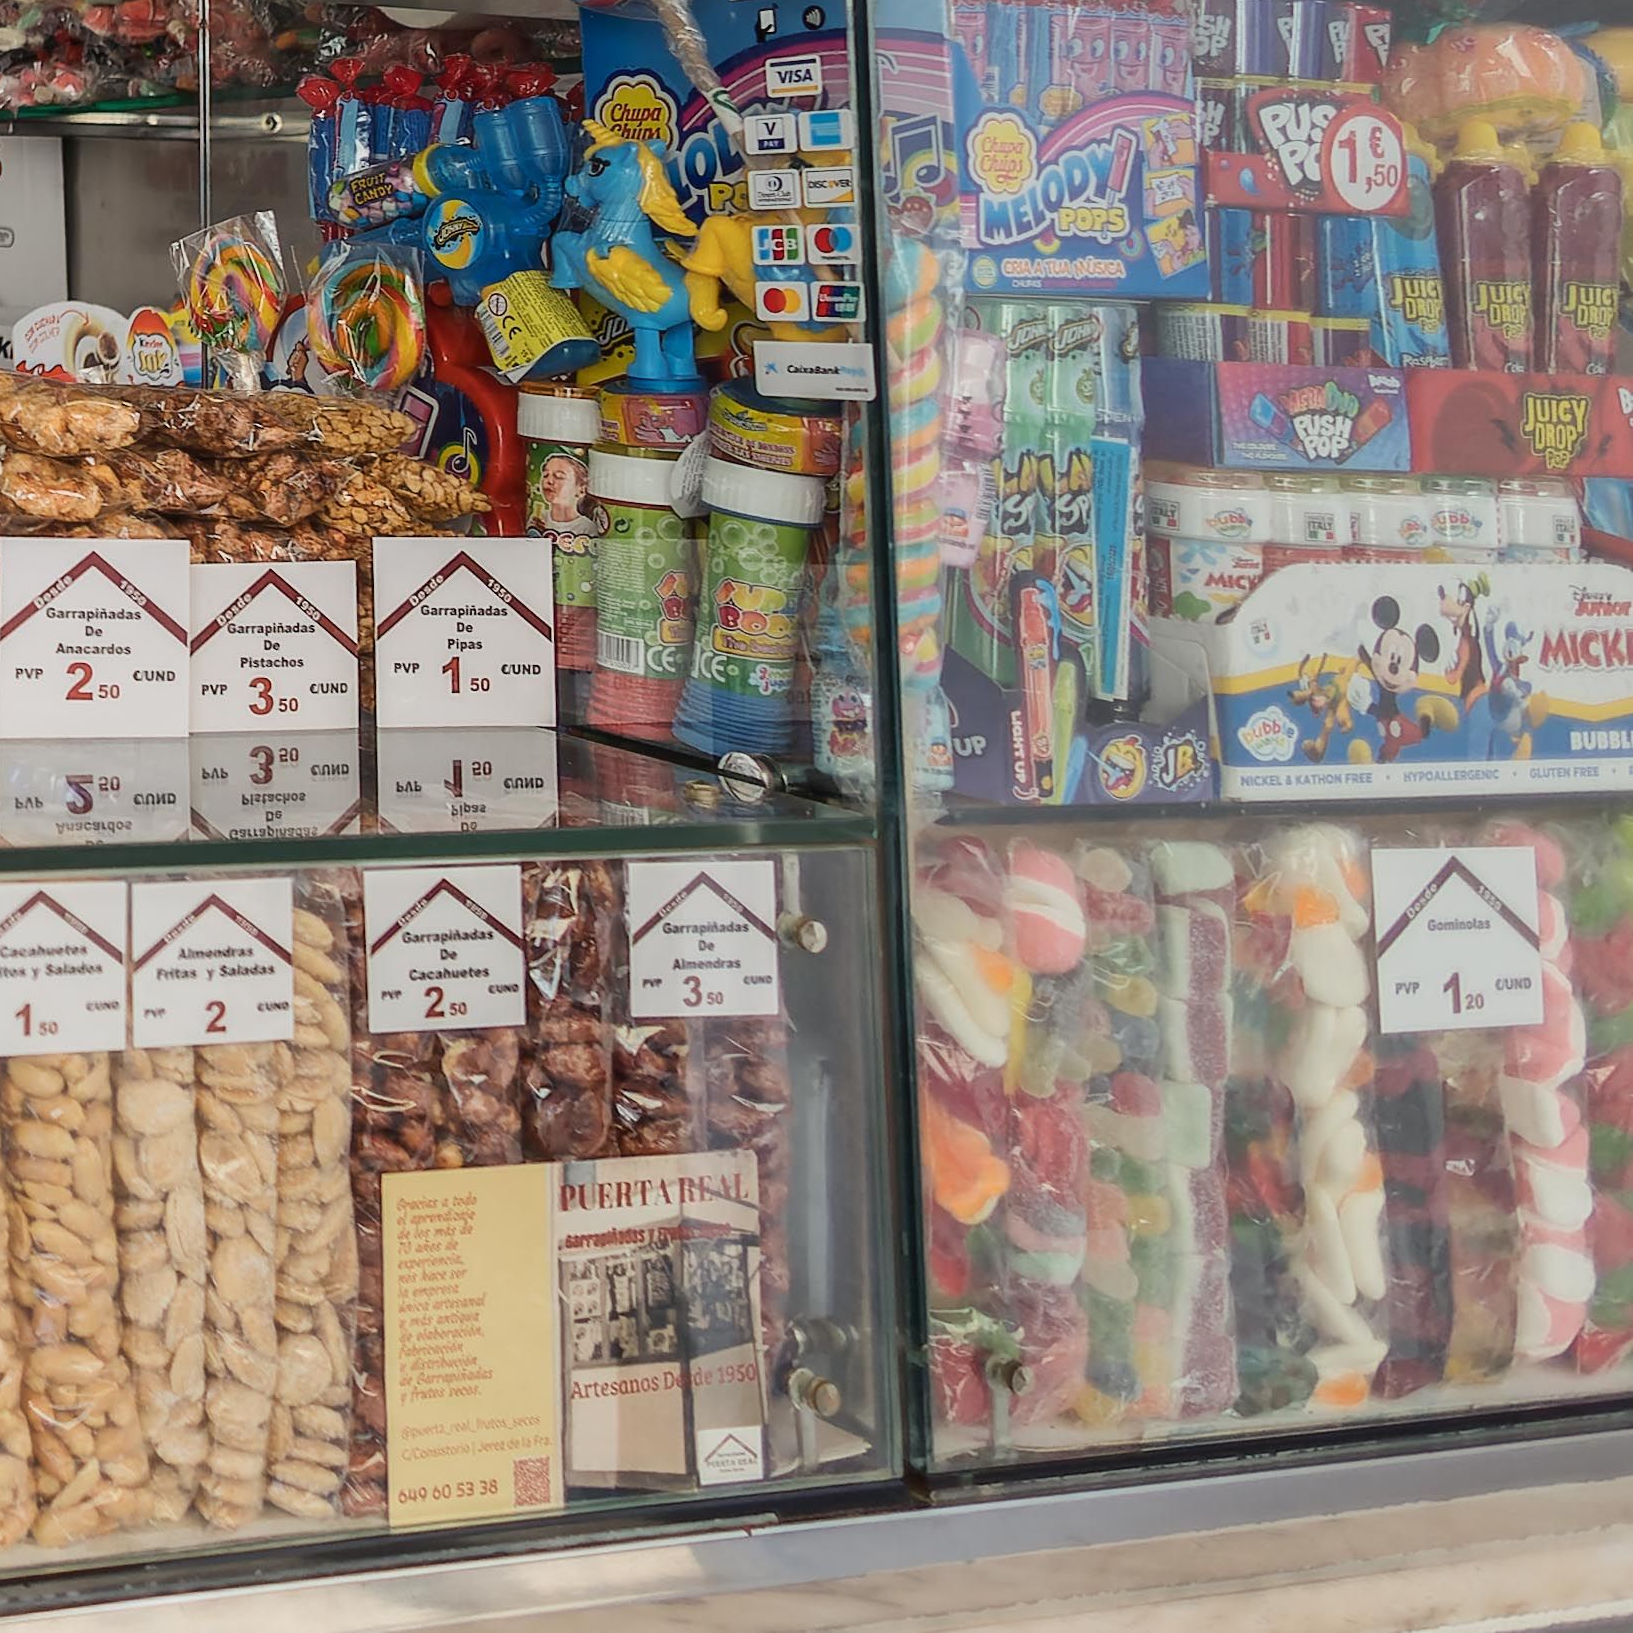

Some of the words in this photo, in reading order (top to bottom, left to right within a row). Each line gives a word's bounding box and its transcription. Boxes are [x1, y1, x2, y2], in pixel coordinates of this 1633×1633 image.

[776, 68, 812, 84] VISA
[610, 103, 661, 124] Chupa
[983, 137, 1023, 154] Chupa
[983, 154, 1023, 173] Chups
[350, 174, 387, 196] FRUIT
[353, 183, 395, 206] CANDY
[1058, 206, 1127, 233] POPS
[1292, 411, 1353, 439] PUSH
[1523, 393, 1588, 436] JUICY
[1302, 432, 1350, 459] POP
[1535, 423, 1581, 453] DROP
[419, 603, 509, 620] Garrapiñadas
[55, 642, 132, 657] Anacardos
[447, 637, 484, 653] Pipas
[239, 655, 305, 669] Pistachos
[66, 662, 95, 701] 2
[98, 684, 120, 699] 50
[394, 662, 420, 674] PVP
[442, 657, 461, 694] 1
[470, 677, 491, 692] 50
[248, 676, 274, 716] 3
[278, 697, 299, 712] 50
[1240, 773, 1283, 788] NICKEL
[1294, 773, 1342, 786] KATHON
[1344, 772, 1373, 784] FREE
[1403, 768, 1500, 783] HYPOALLERGENIC
[1529, 766, 1568, 780] GLUTEN
[1571, 766, 1600, 778] FREE
[662, 921, 750, 935] Garrapiñadas
[1427, 914, 1491, 934] Gominolas
[402, 929, 494, 945] Garrapiñadas
[409, 966, 490, 982] Cacahuetes
[672, 957, 742, 971] Almendras
[424, 986, 445, 1019] 2
[449, 1001, 468, 1017] 50
[683, 976, 703, 1008] 3
[706, 991, 724, 1005] 50
[1394, 980, 1421, 996] PVP
[1442, 972, 1461, 1015] 1
[205, 1001, 227, 1033] 2
[558, 1178, 674, 1213] PUERTA
[678, 1171, 749, 1204] REAL
[570, 1374, 660, 1400] Artesanos
[715, 1361, 758, 1385] 1950
[398, 1485, 428, 1505] 649
[433, 1483, 452, 1500] 60
[455, 1481, 476, 1498] 53
[479, 1478, 499, 1496] 38
